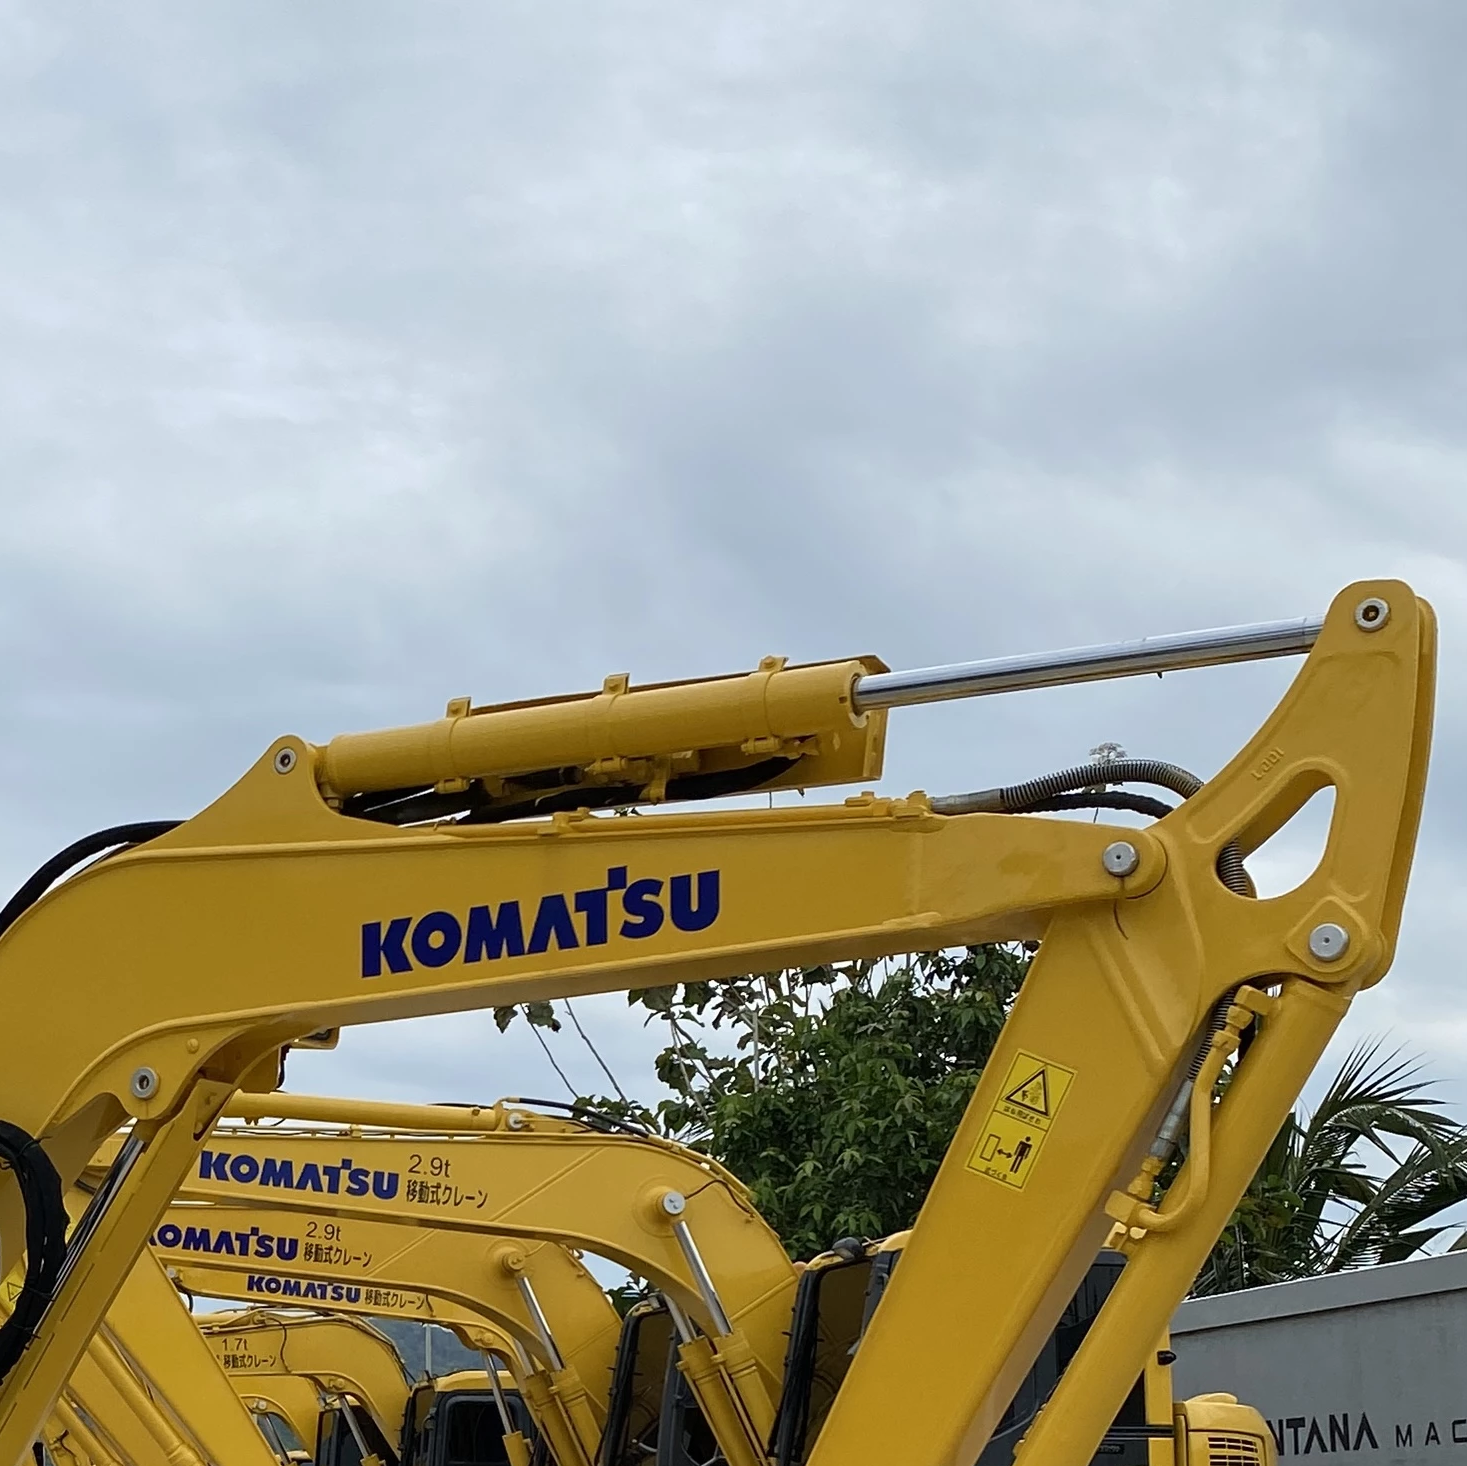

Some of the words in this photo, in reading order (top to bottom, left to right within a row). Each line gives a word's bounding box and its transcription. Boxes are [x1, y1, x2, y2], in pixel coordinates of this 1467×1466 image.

[362, 866, 720, 978] KOMATSU
[199, 1151, 399, 1200] KOMATSU
[408, 1154, 451, 1178] 2.9t
[406, 1180, 488, 1209] 移動式クレーン
[305, 1221, 341, 1242] 2.9t
[304, 1242, 372, 1267] 移動式クレーン
[247, 1275, 361, 1304] KOMATSU
